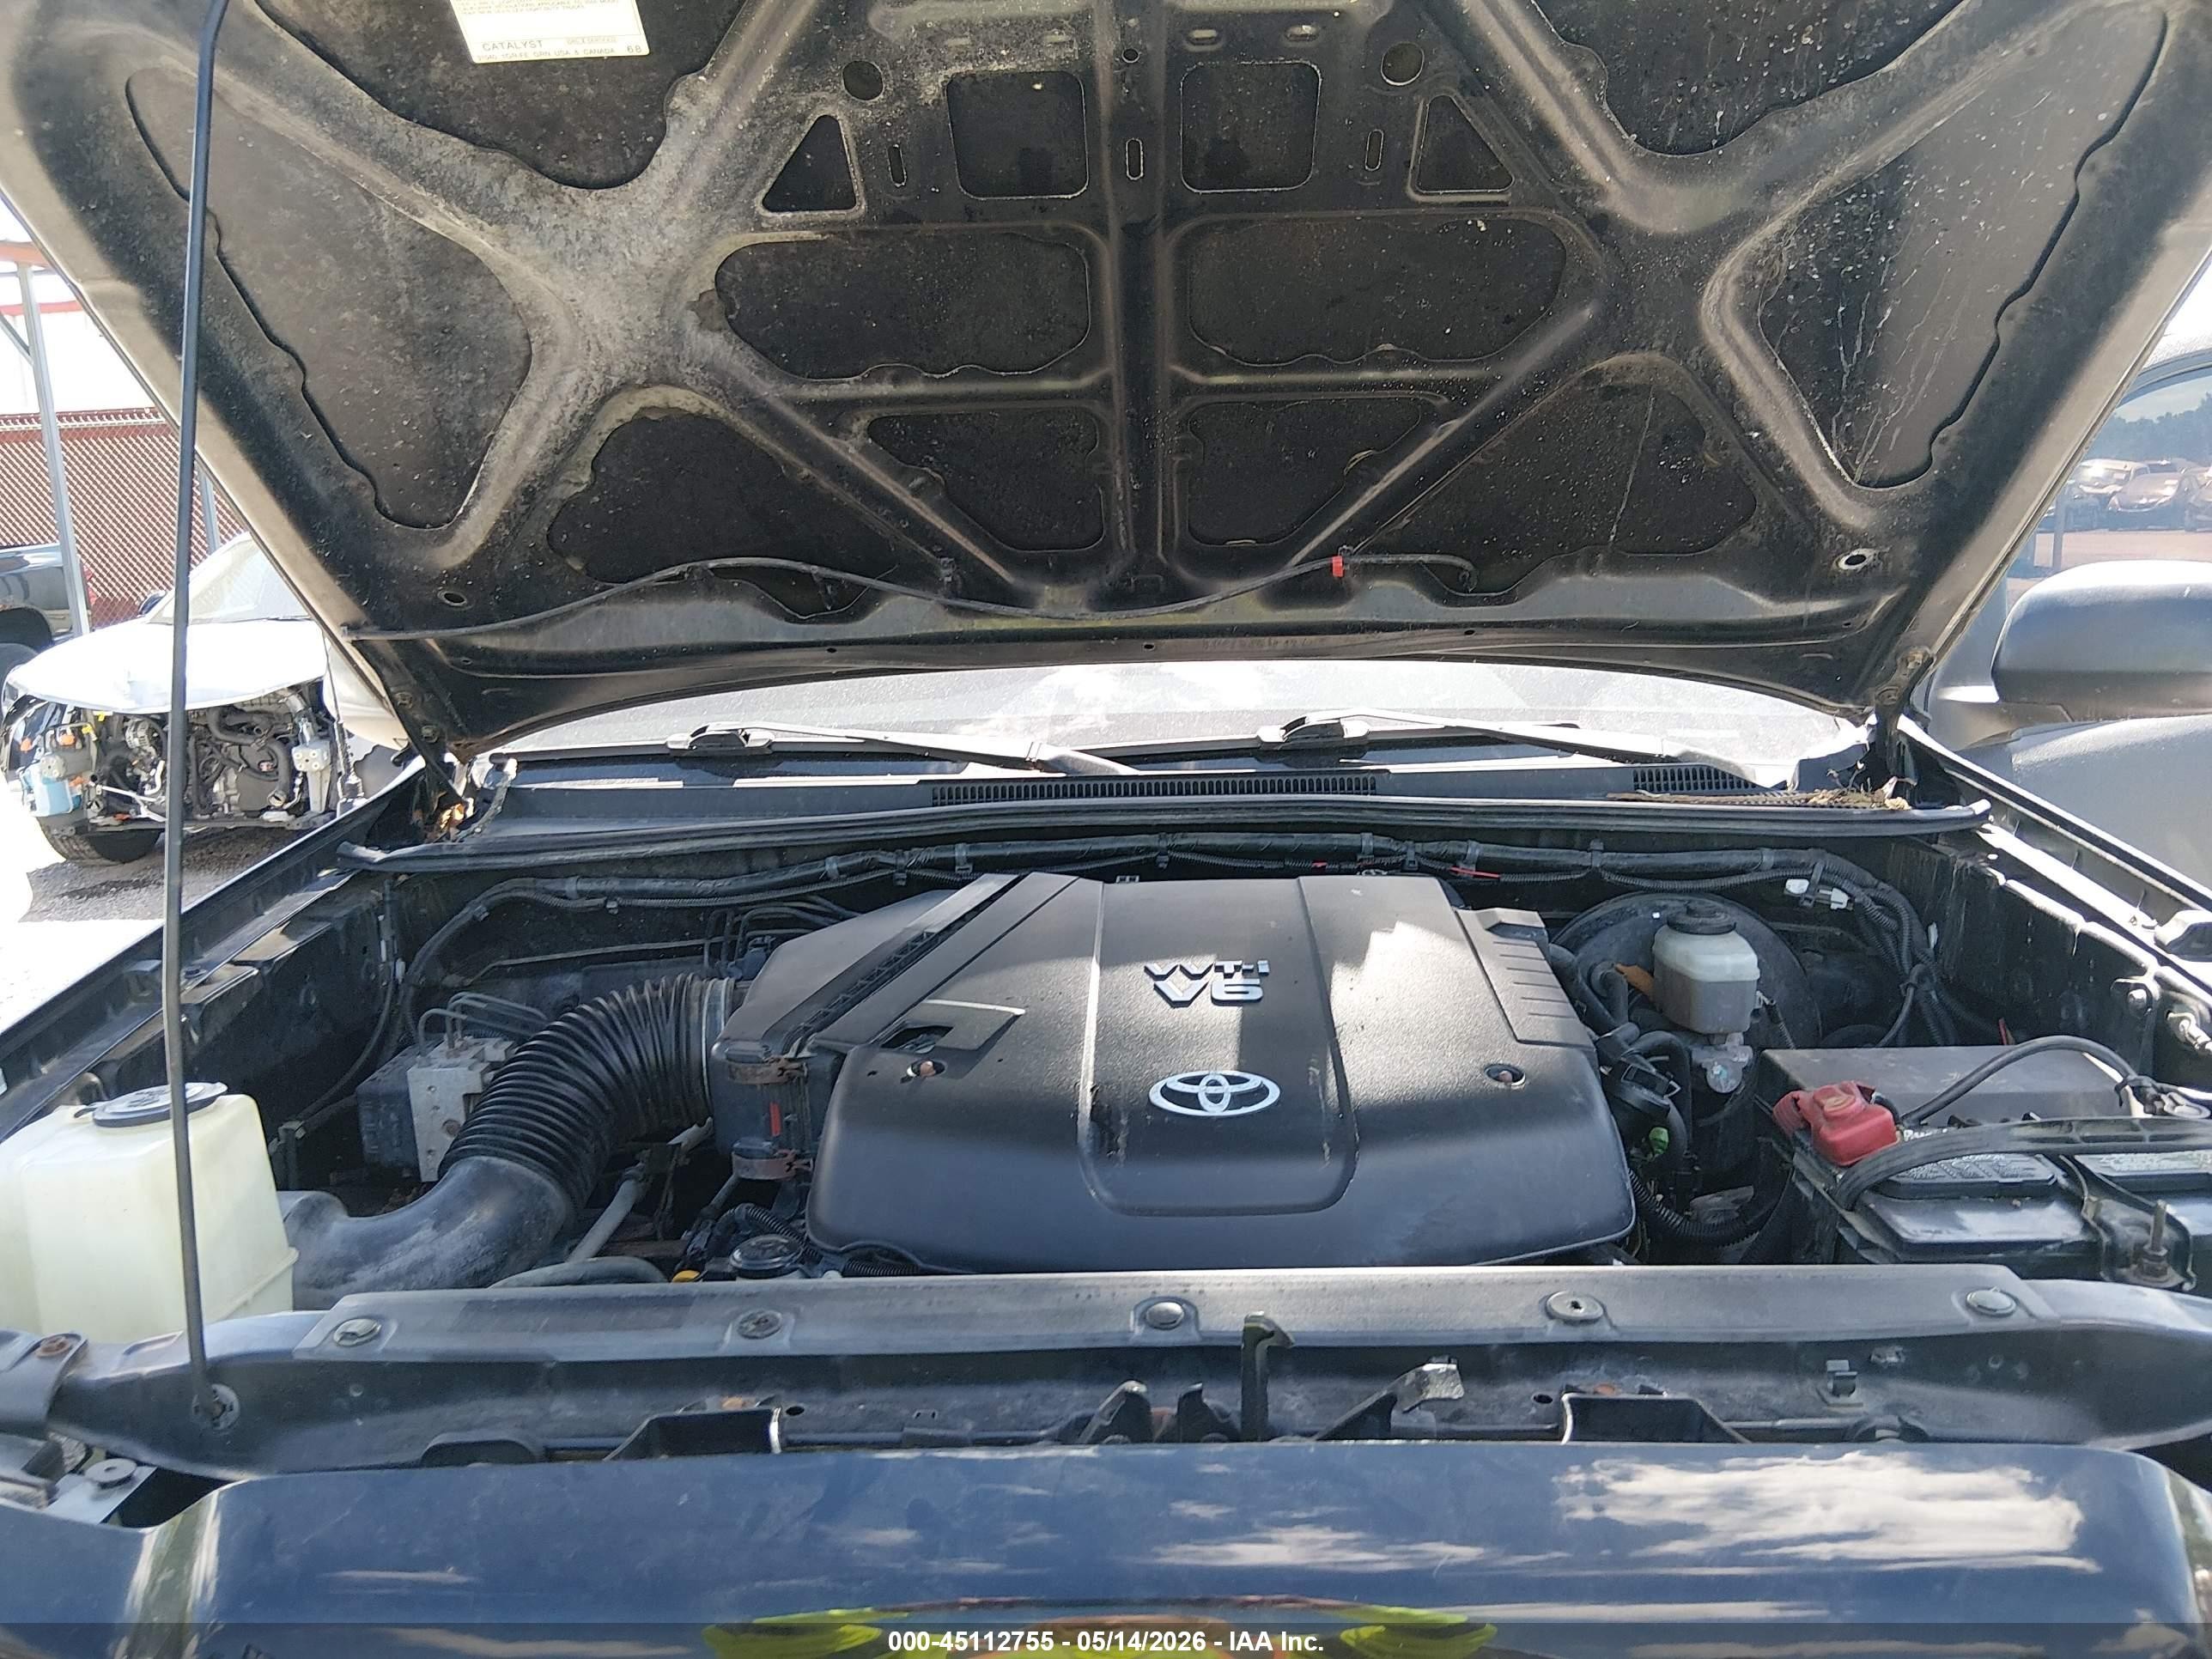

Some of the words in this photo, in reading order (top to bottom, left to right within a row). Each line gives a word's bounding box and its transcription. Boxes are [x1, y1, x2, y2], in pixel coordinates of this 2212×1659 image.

[482, 40, 544, 52] CATALYST
[627, 45, 642, 54] 68
[1153, 977, 1264, 1008] V6
